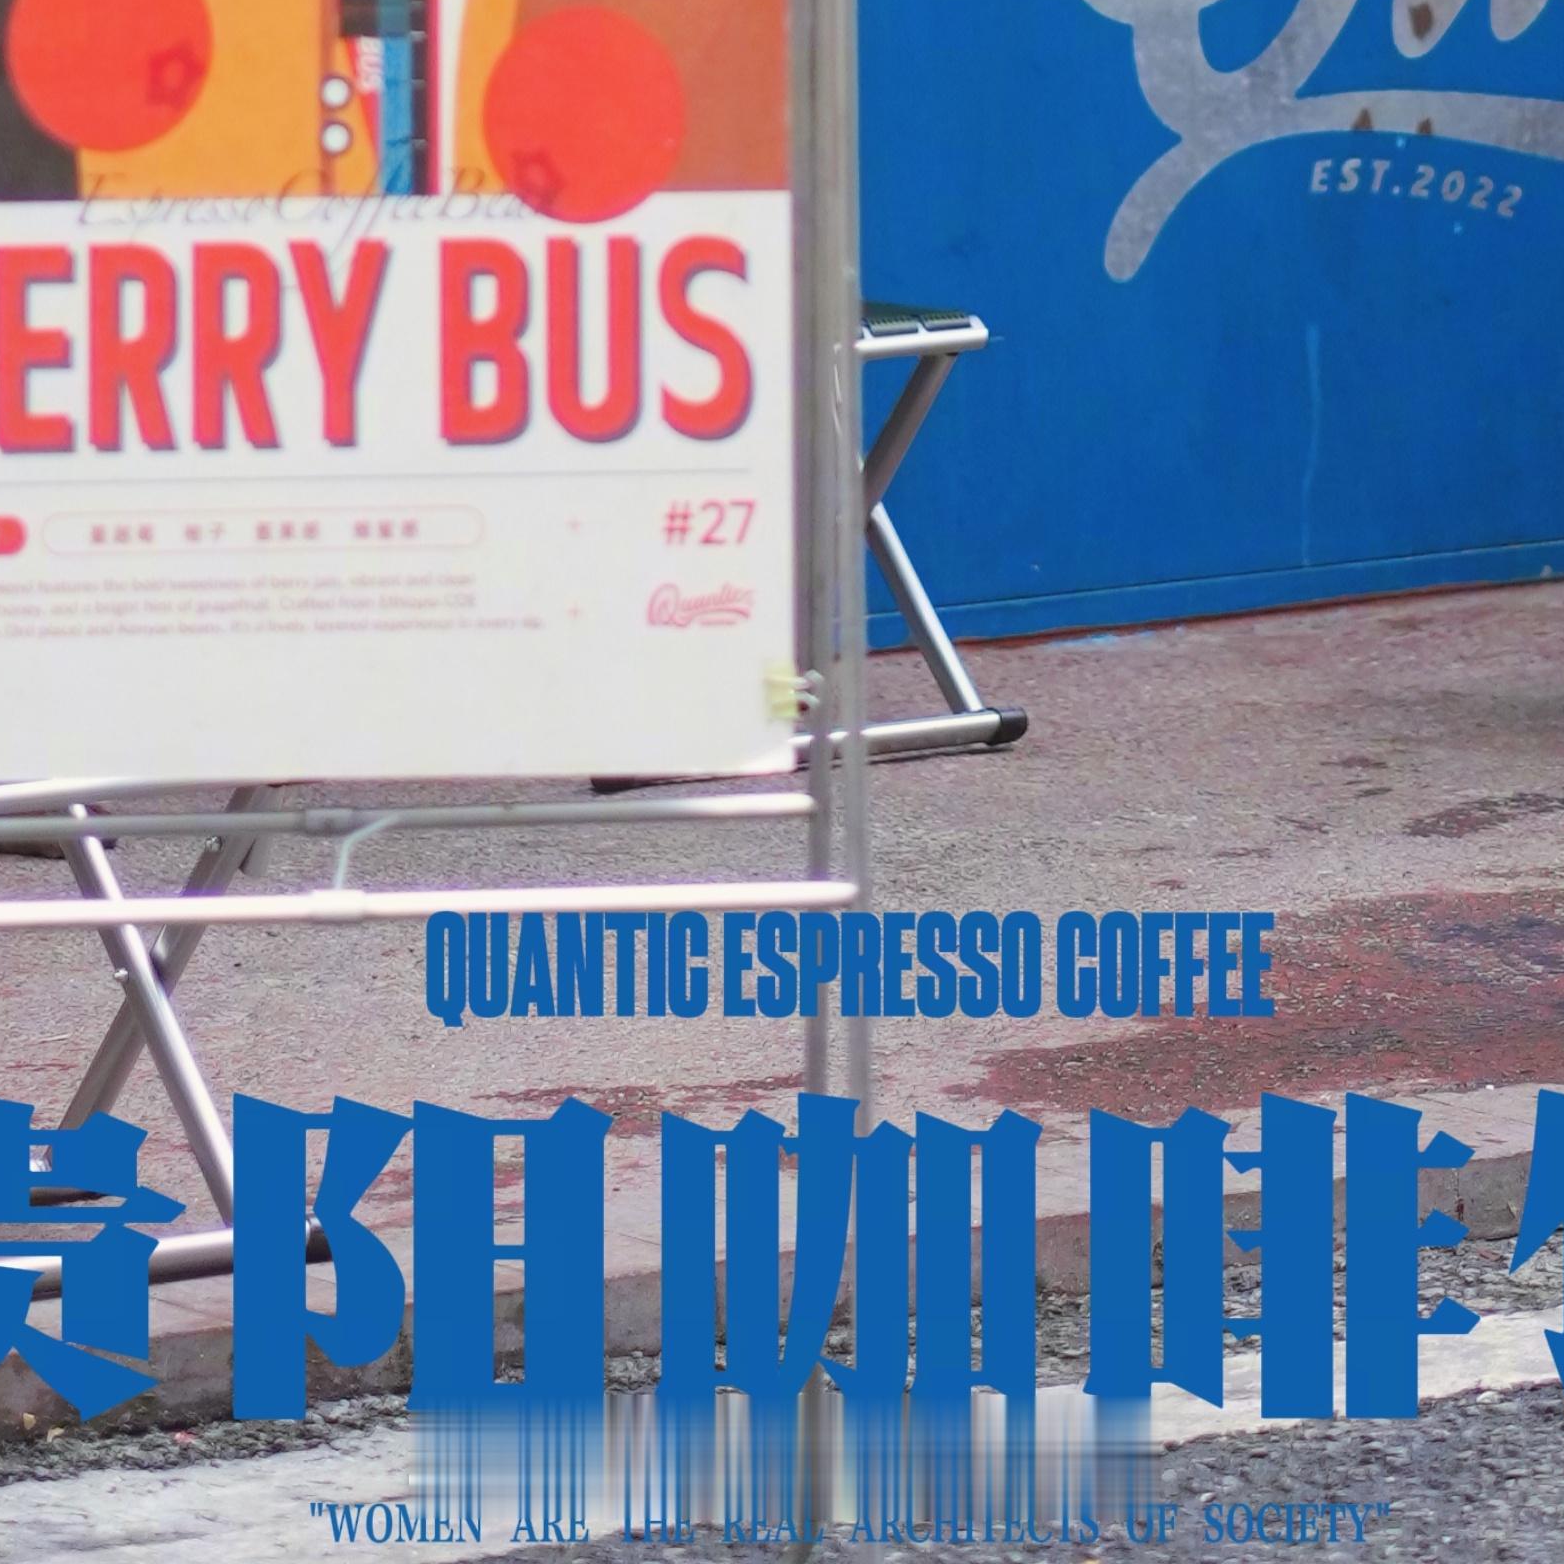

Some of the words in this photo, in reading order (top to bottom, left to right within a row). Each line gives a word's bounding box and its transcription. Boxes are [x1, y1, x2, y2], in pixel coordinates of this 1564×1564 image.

[1309, 157, 1524, 220] EST.2022
[438, 234, 755, 445] BUS
[661, 499, 757, 548] #27
